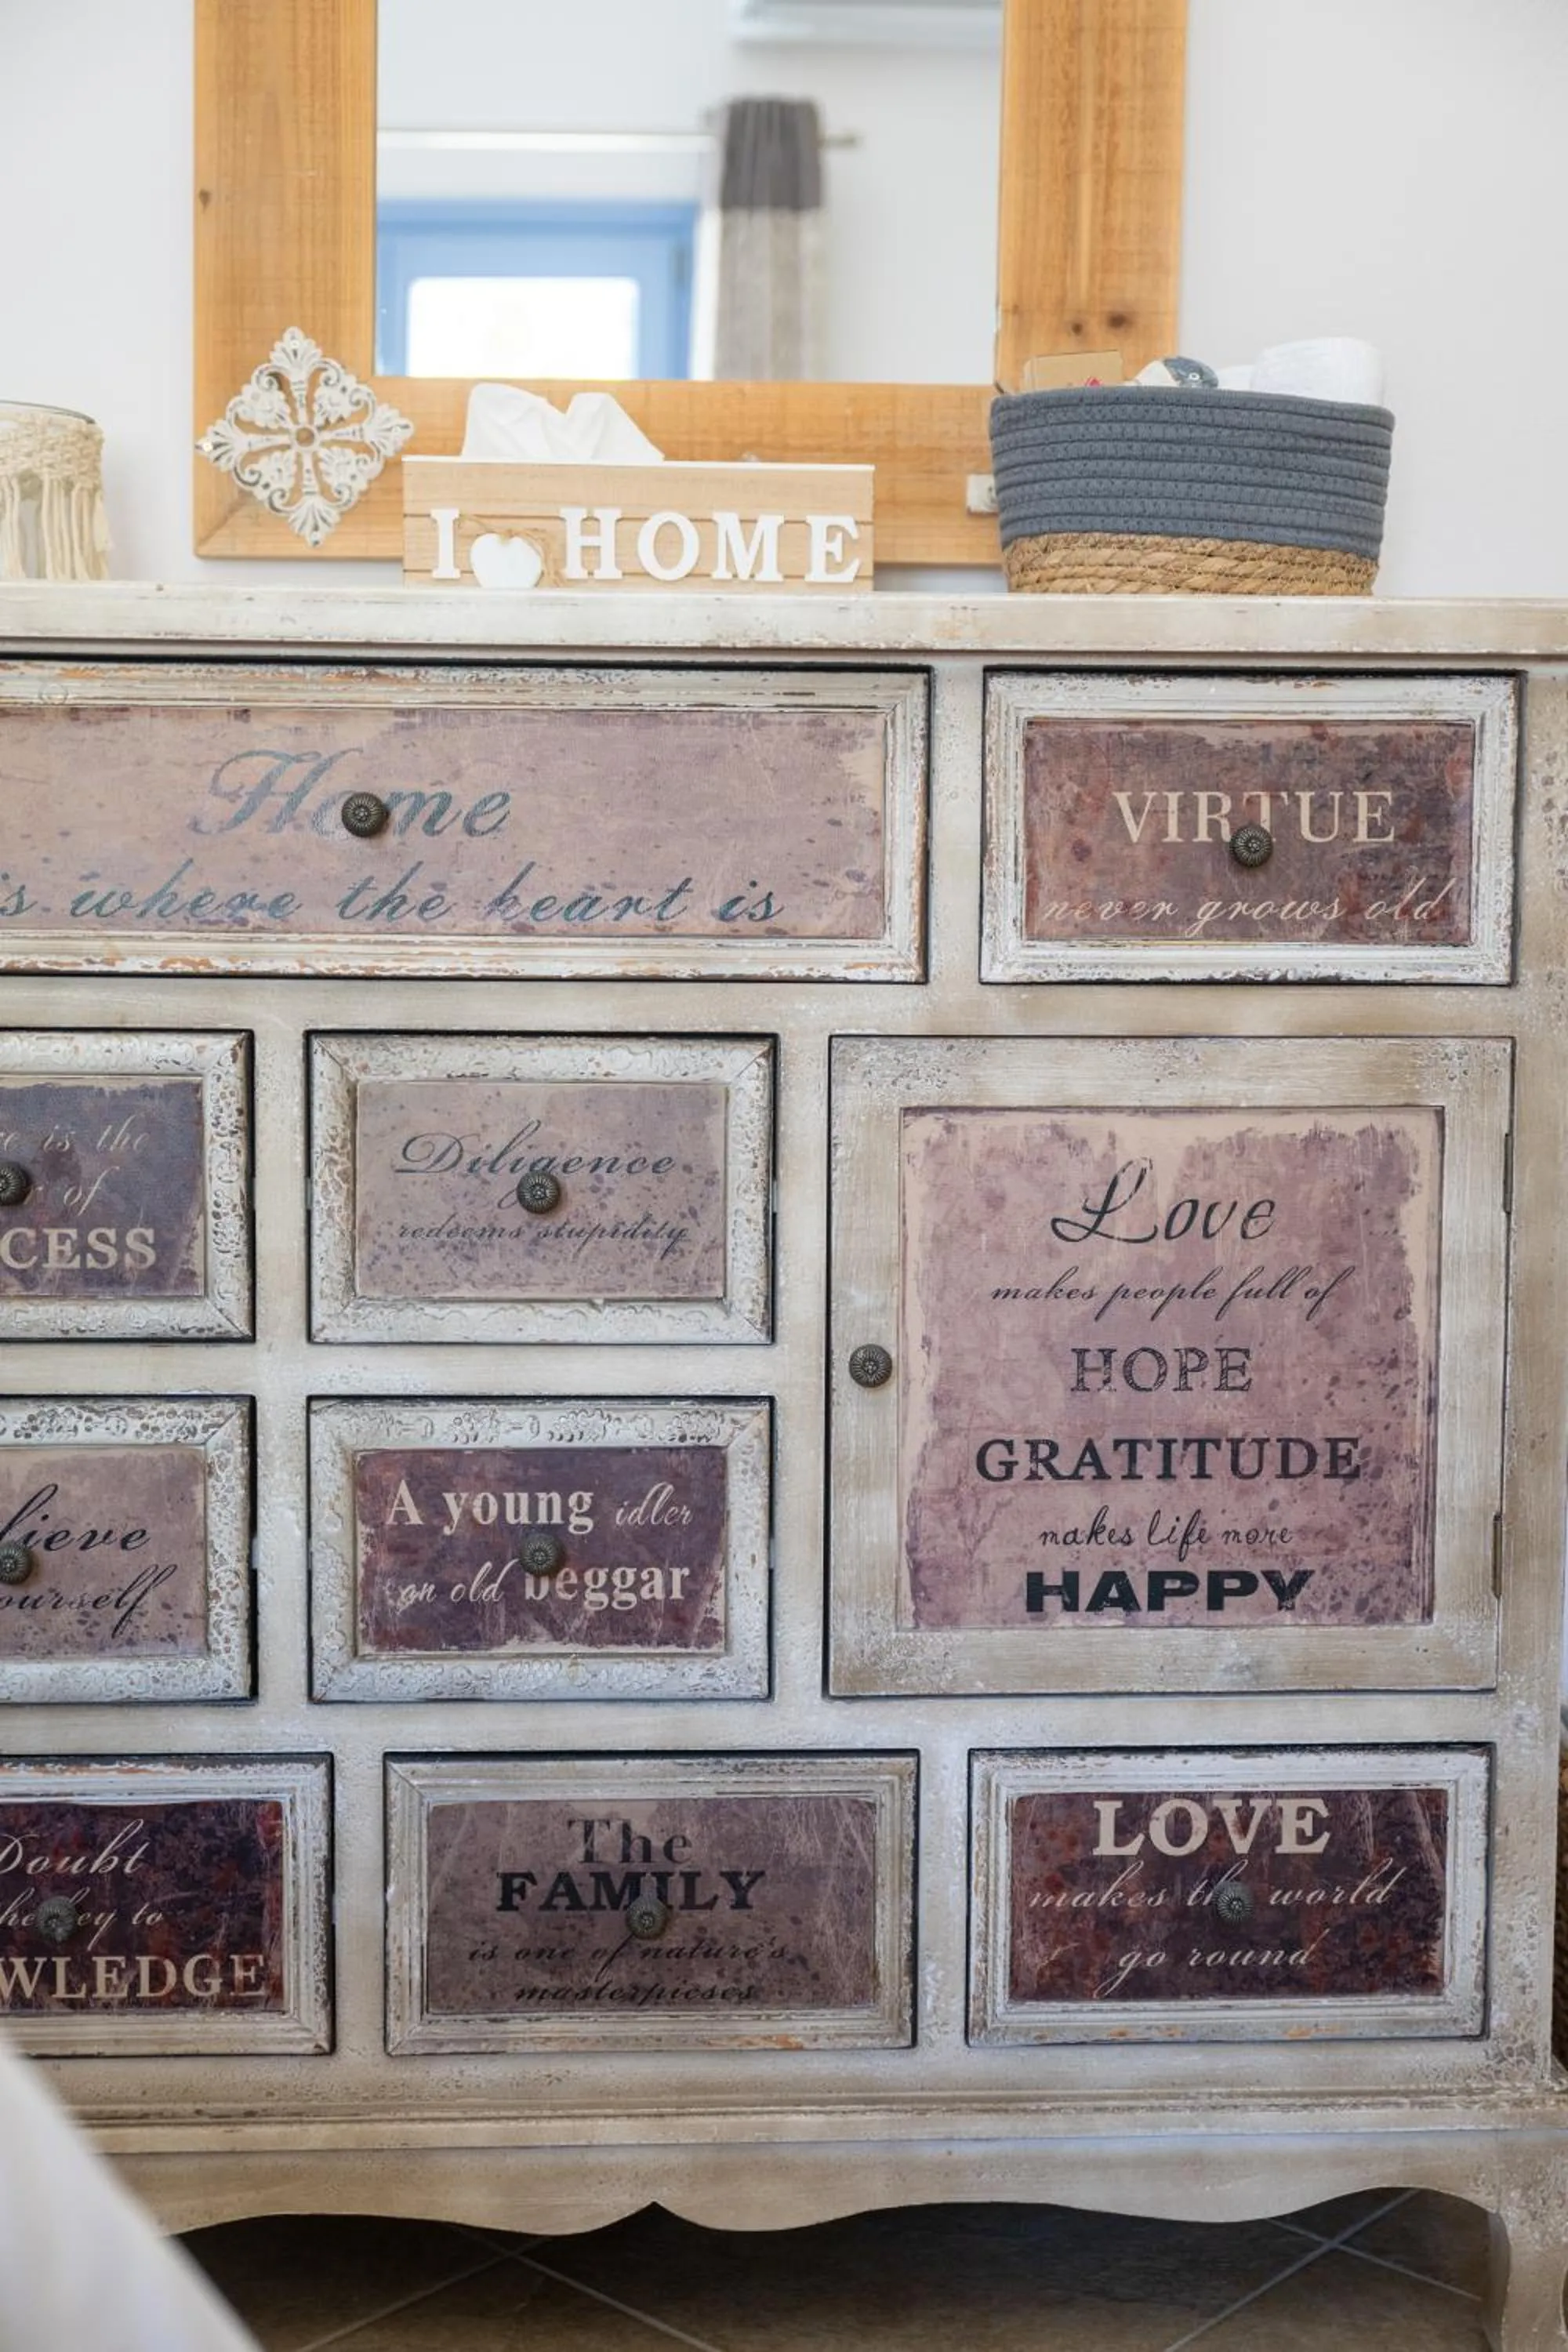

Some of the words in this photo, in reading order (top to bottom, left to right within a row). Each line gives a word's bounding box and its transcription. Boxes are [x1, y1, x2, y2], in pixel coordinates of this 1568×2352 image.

[430, 509, 461, 579] I
[559, 507, 861, 583] HOME
[1112, 791, 1396, 844] VIRTUE
[69, 858, 303, 920] where
[336, 861, 456, 921] the
[488, 861, 693, 922] heart
[716, 880, 786, 922] is
[1042, 900, 1179, 920] never
[1185, 897, 1348, 938] grows
[1364, 877, 1457, 920] old
[42, 1124, 77, 1152] is
[96, 1113, 151, 1152] the
[394, 1118, 677, 1210] Diligence
[63, 1166, 120, 1216] of
[1051, 1156, 1277, 1243] Love
[397, 1212, 526, 1241] redeems
[537, 1211, 691, 1261] stupidity
[991, 1266, 1096, 1300] makes
[1095, 1266, 1220, 1321] people
[1214, 1266, 1301, 1321] full
[1303, 1266, 1356, 1322] of
[1070, 1347, 1253, 1392] HOPE
[975, 1438, 1361, 1483] GRATITUDE
[387, 1479, 423, 1526] A
[442, 1491, 594, 1535] young
[615, 1482, 695, 1527] idler
[1040, 1505, 1136, 1546] makes
[1147, 1509, 1210, 1563] life
[1222, 1531, 1294, 1546] more
[450, 1558, 521, 1602] old
[1025, 1570, 1315, 1613] HAPPY
[568, 1818, 693, 1864] The
[1092, 1798, 1330, 1857] LOVE
[495, 1871, 765, 1911] FAMILY
[1029, 1860, 1166, 1907] makes
[1269, 1858, 1406, 1906] world
[132, 1902, 164, 1925] to
[469, 1942, 497, 1961] is
[514, 1947, 575, 1961] one
[1094, 1949, 1167, 1998] go
[1189, 1929, 1330, 1967] round
